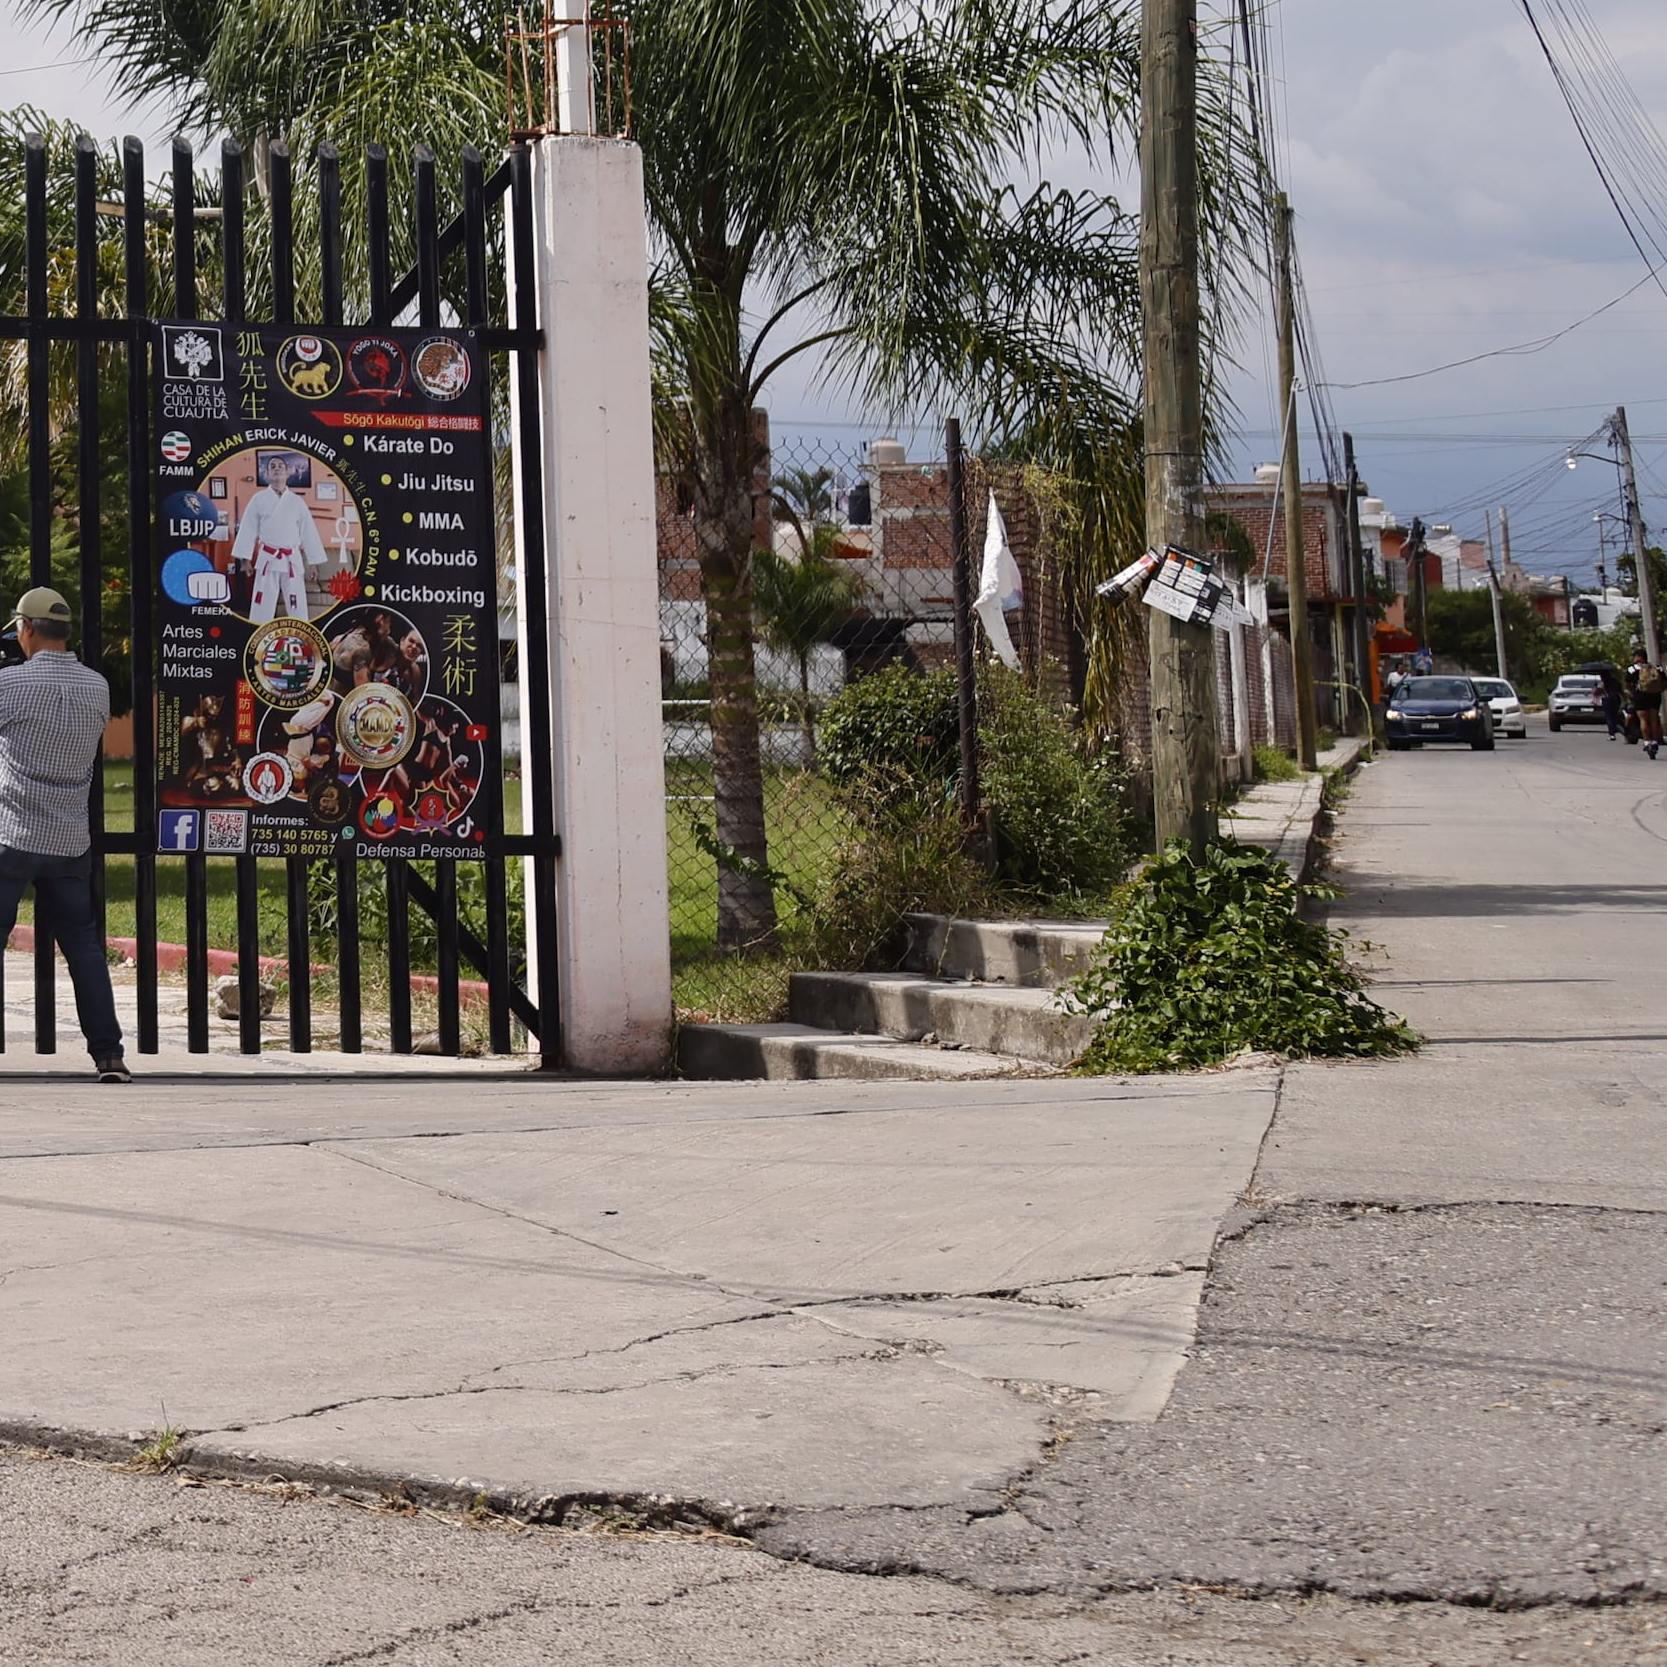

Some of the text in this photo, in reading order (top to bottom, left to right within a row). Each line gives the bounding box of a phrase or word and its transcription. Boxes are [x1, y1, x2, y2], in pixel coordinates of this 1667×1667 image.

[163, 383, 226, 398] CASA DE LA
[163, 395, 228, 409] CULTURA DE
[163, 406, 230, 420] CUAUTLA
[196, 427, 337, 469] SHIHAN ERICK JAVIER
[363, 434, 454, 455] Kárate Do
[159, 465, 194, 477] FAMM
[398, 472, 475, 492] Jiu Jitsu
[419, 512, 465, 531] MMA
[366, 545, 380, 577] DAN
[380, 584, 485, 608] Kickboxing
[191, 605, 233, 616] FEMEKA
[162, 623, 204, 639] Artes
[163, 643, 237, 660] Marciales
[163, 662, 214, 679] Mixtas
[279, 681, 326, 707] MARCIALES
[251, 814, 309, 826] Informes:
[251, 828, 339, 843] 735 140 5765 y
[250, 843, 335, 856] (735) 30 80787
[356, 842, 486, 859] Defensa Personal
